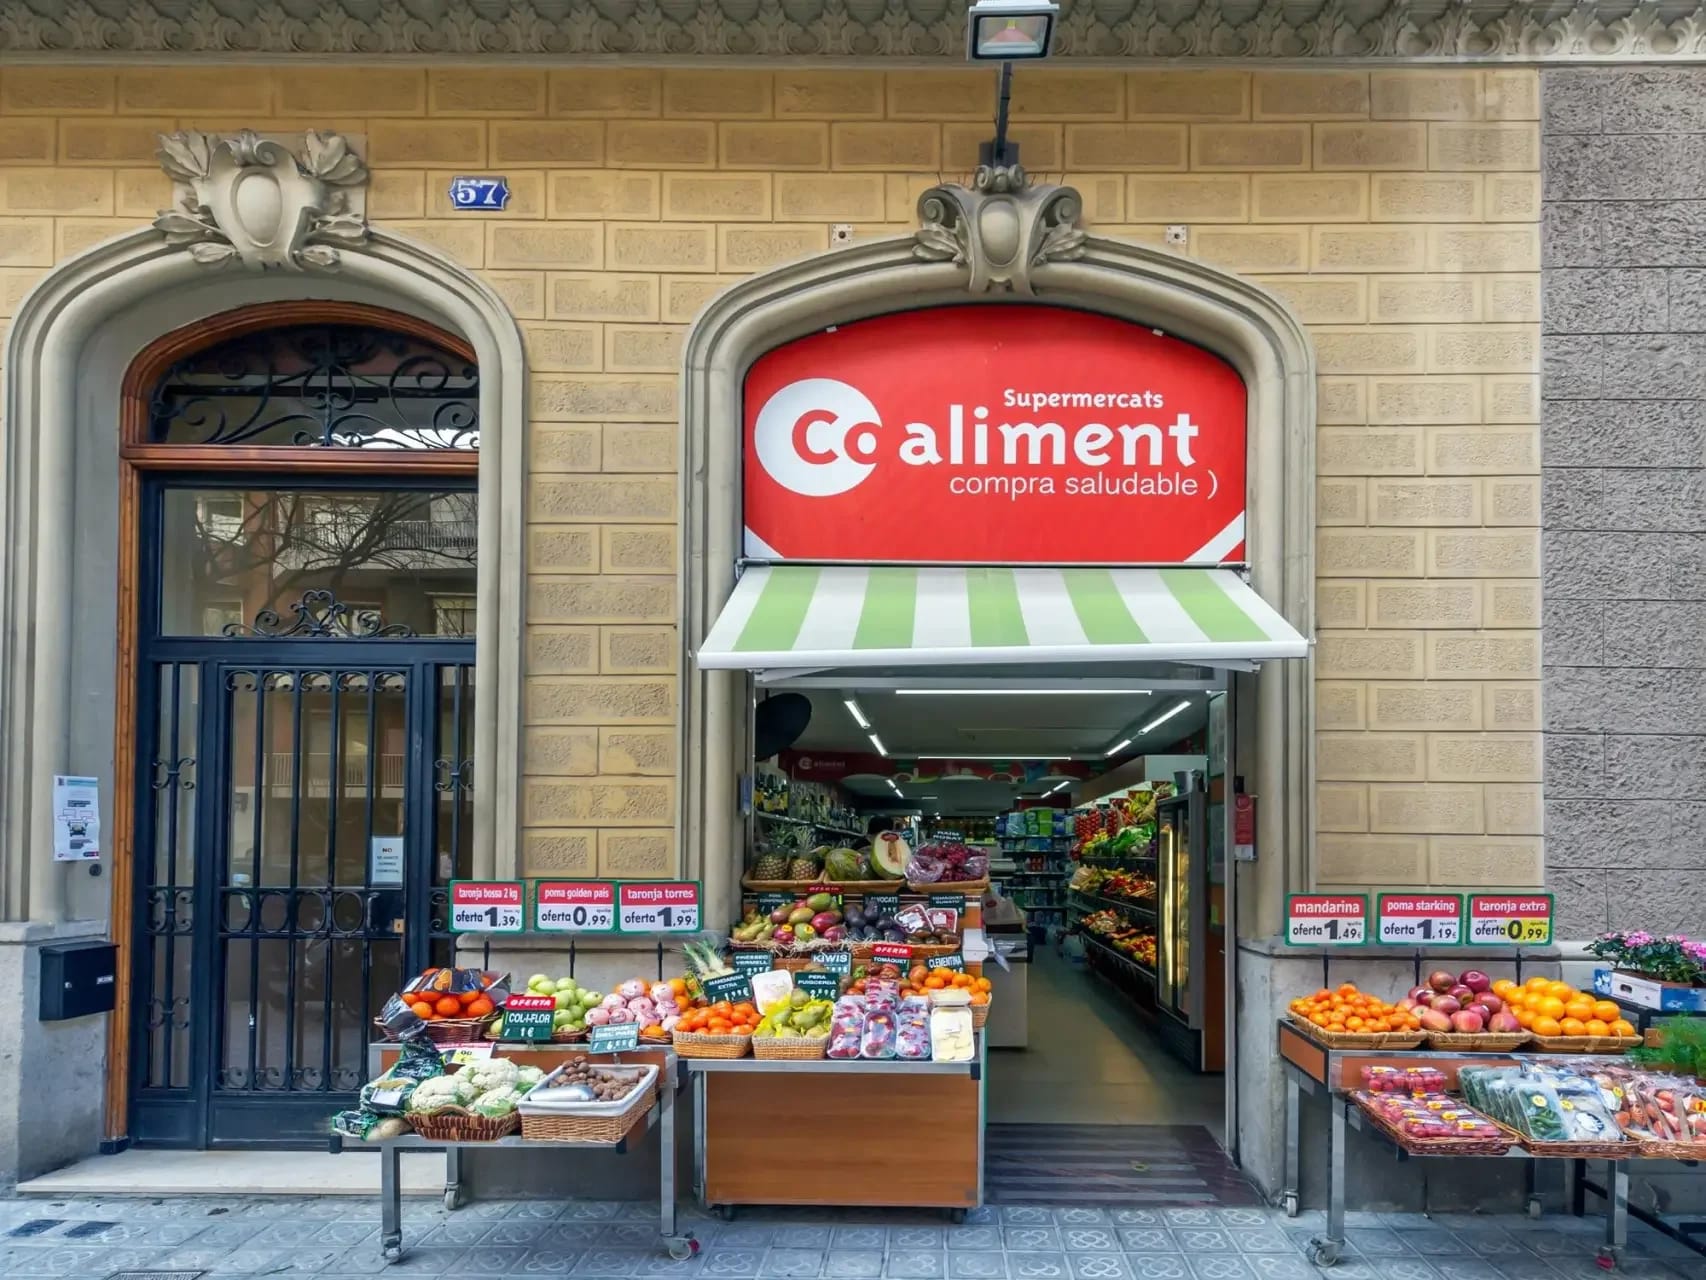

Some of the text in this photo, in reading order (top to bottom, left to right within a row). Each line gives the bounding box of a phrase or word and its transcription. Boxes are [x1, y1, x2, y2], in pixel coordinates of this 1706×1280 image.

[456, 180, 499, 204] 57
[1003, 388, 1164, 412] Supermercats
[899, 403, 1199, 467] aliment
[949, 475, 1055, 502] compra
[1065, 471, 1198, 496] saludable
[458, 887, 482, 901] taronja
[503, 887, 509, 899] 2
[509, 887, 518, 901] kg
[544, 889, 566, 900] poma
[566, 888, 593, 900] golden
[627, 888, 694, 902] taronja torres
[1295, 899, 1360, 914] mandarina
[1387, 899, 1455, 914] poma starking
[1479, 899, 1547, 914] taronja extra
[455, 909, 483, 922] oferta
[541, 909, 572, 922] oferta
[624, 911, 656, 924] oferta
[1292, 923, 1323, 936] oferta
[1384, 922, 1416, 935] oferta
[1475, 924, 1506, 936] oferta
[875, 946, 909, 955] OFERTA
[813, 953, 848, 964] KIWIS
[928, 955, 962, 969] CLEMENTINA
[717, 981, 738, 990] EXTRA
[509, 998, 552, 1007] OFERTA
